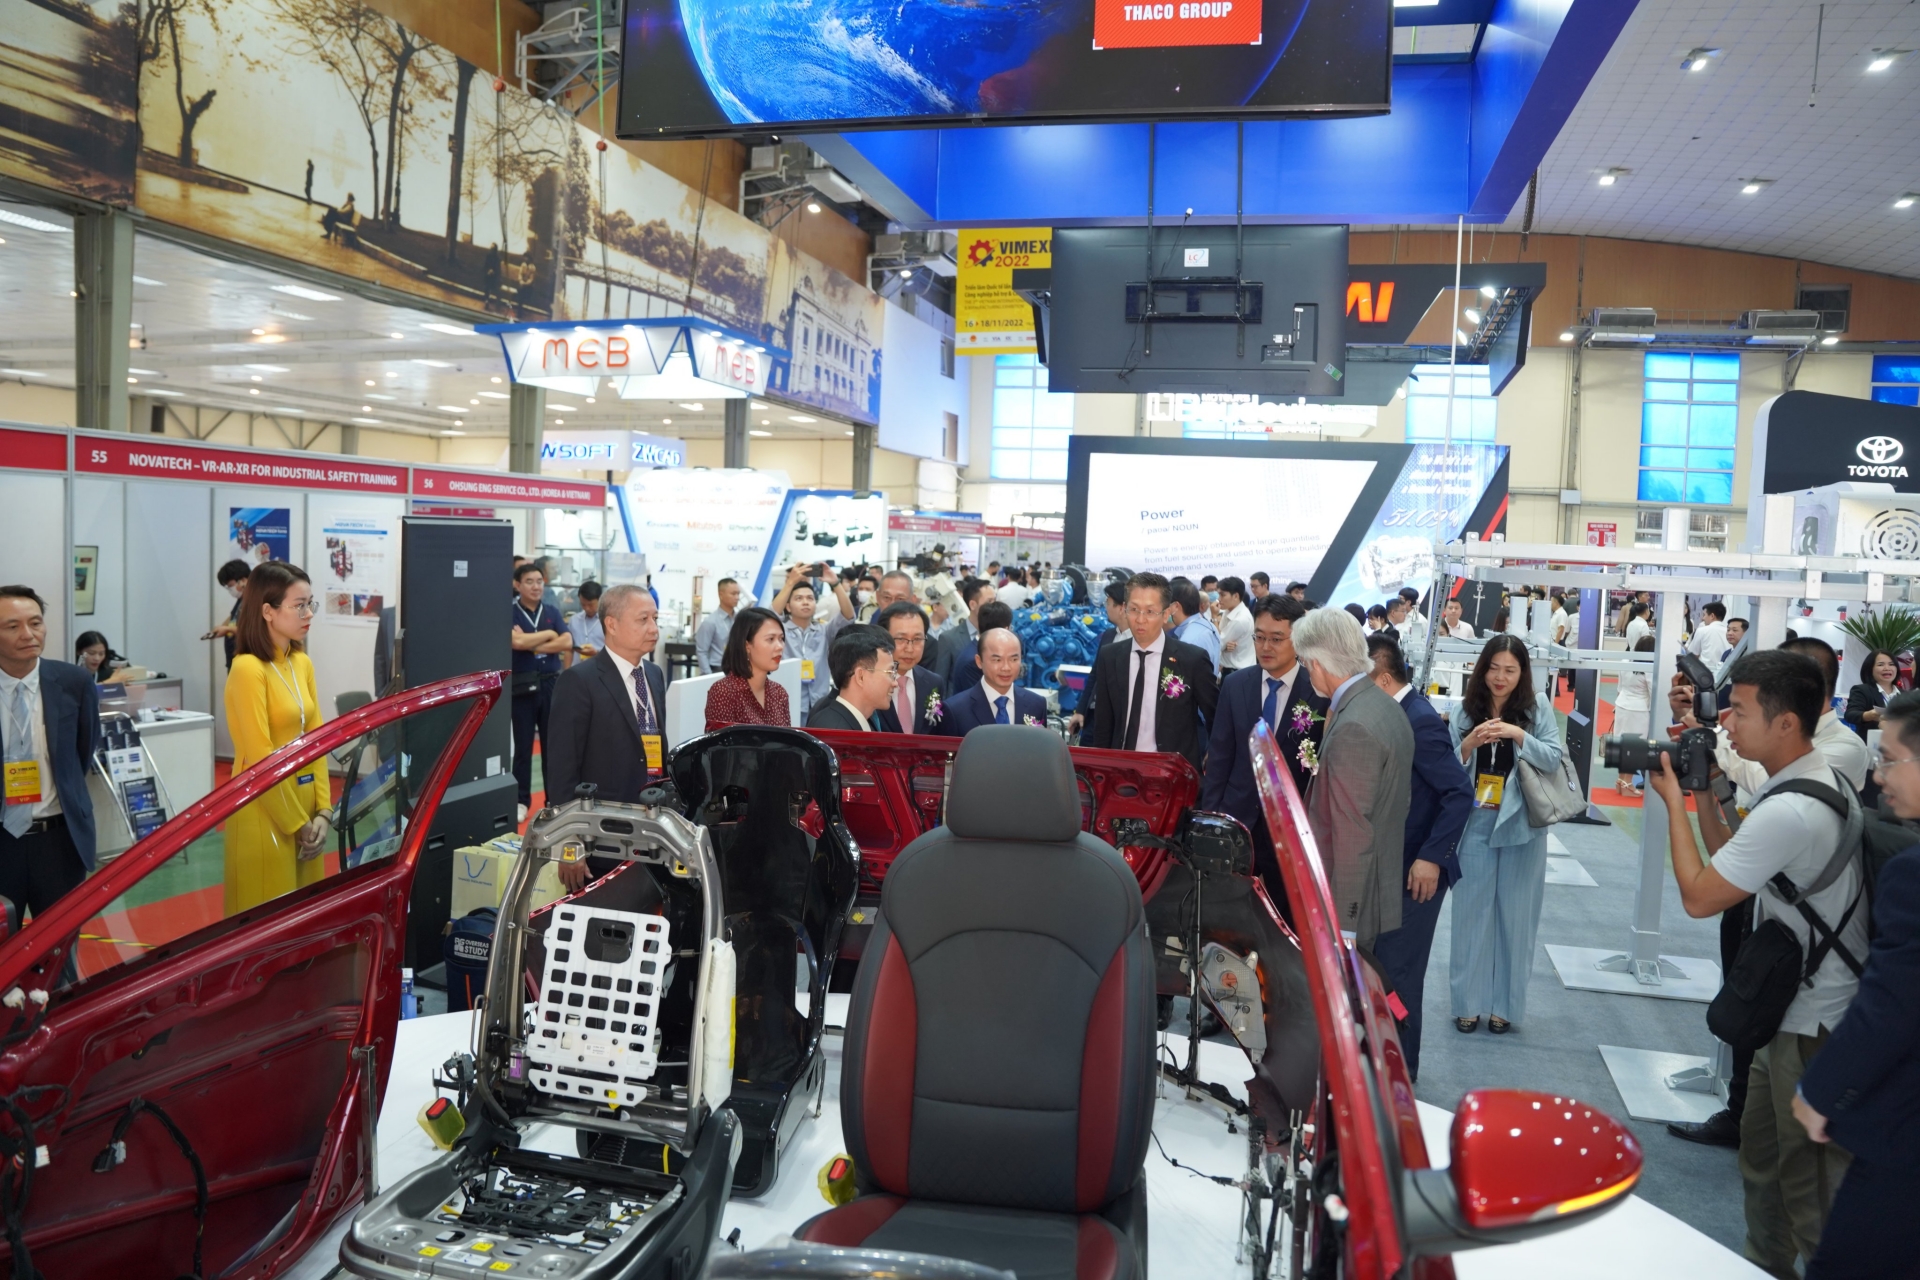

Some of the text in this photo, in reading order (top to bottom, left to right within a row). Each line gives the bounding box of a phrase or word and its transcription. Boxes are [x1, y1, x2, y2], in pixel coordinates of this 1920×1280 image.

[1124, 2, 1233, 21] THACO GROUP
[1000, 240, 1051, 254] VIMEX
[995, 255, 1029, 267] 2022
[981, 319, 1023, 328] 18/11/2022
[714, 345, 756, 385] MEB
[91, 450, 108, 463] 55
[129, 453, 192, 470] NOVATECH
[251, 464, 271, 477] FOR
[272, 467, 326, 481] INDUSTRIAL
[327, 470, 359, 483] SAFETY
[359, 472, 398, 486] TRAINING
[1847, 465, 1909, 478] TOYOTA
[424, 478, 434, 488] 56
[449, 480, 478, 493] OHSUNG
[479, 484, 492, 494] ENG
[492, 485, 517, 496] SERVICE
[1140, 509, 1184, 521] Power
[1172, 523, 1199, 532] NOUN
[1144, 546, 1169, 554] Power
[1180, 543, 1208, 552] energy
[1210, 540, 1245, 550] obtained
[1257, 537, 1278, 546] large
[1280, 534, 1320, 545] quantities
[1182, 553, 1214, 561] sources
[1216, 551, 1231, 559] and
[1233, 549, 1253, 557] used
[1266, 545, 1297, 556] operate
[1145, 564, 1184, 573] machines
[464, 945, 489, 957] STUDY
